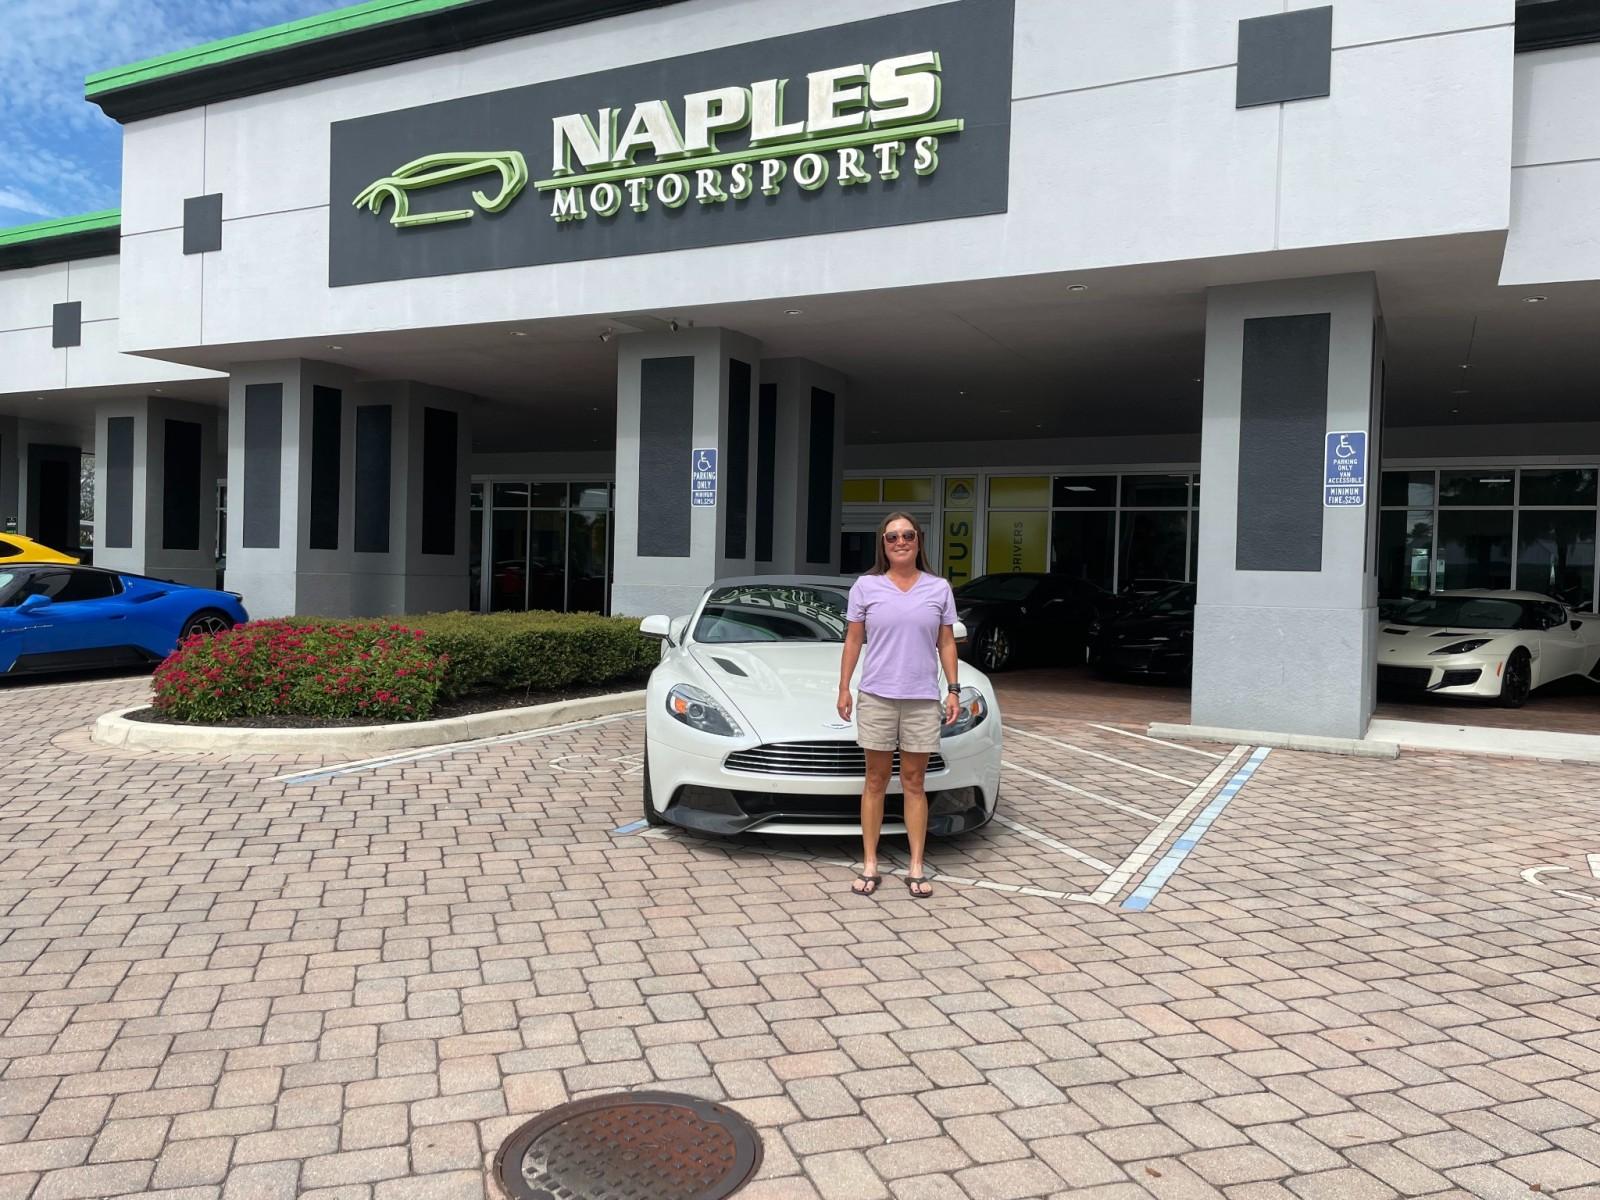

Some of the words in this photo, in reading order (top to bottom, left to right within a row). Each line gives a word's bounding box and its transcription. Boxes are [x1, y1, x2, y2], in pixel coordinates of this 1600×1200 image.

[551, 50, 942, 177] NAPLES
[550, 136, 940, 222] MOTORSPORTS
[693, 471, 716, 481] PARKING
[696, 480, 712, 489] ONLY
[1330, 487, 1359, 496] MINIMUM
